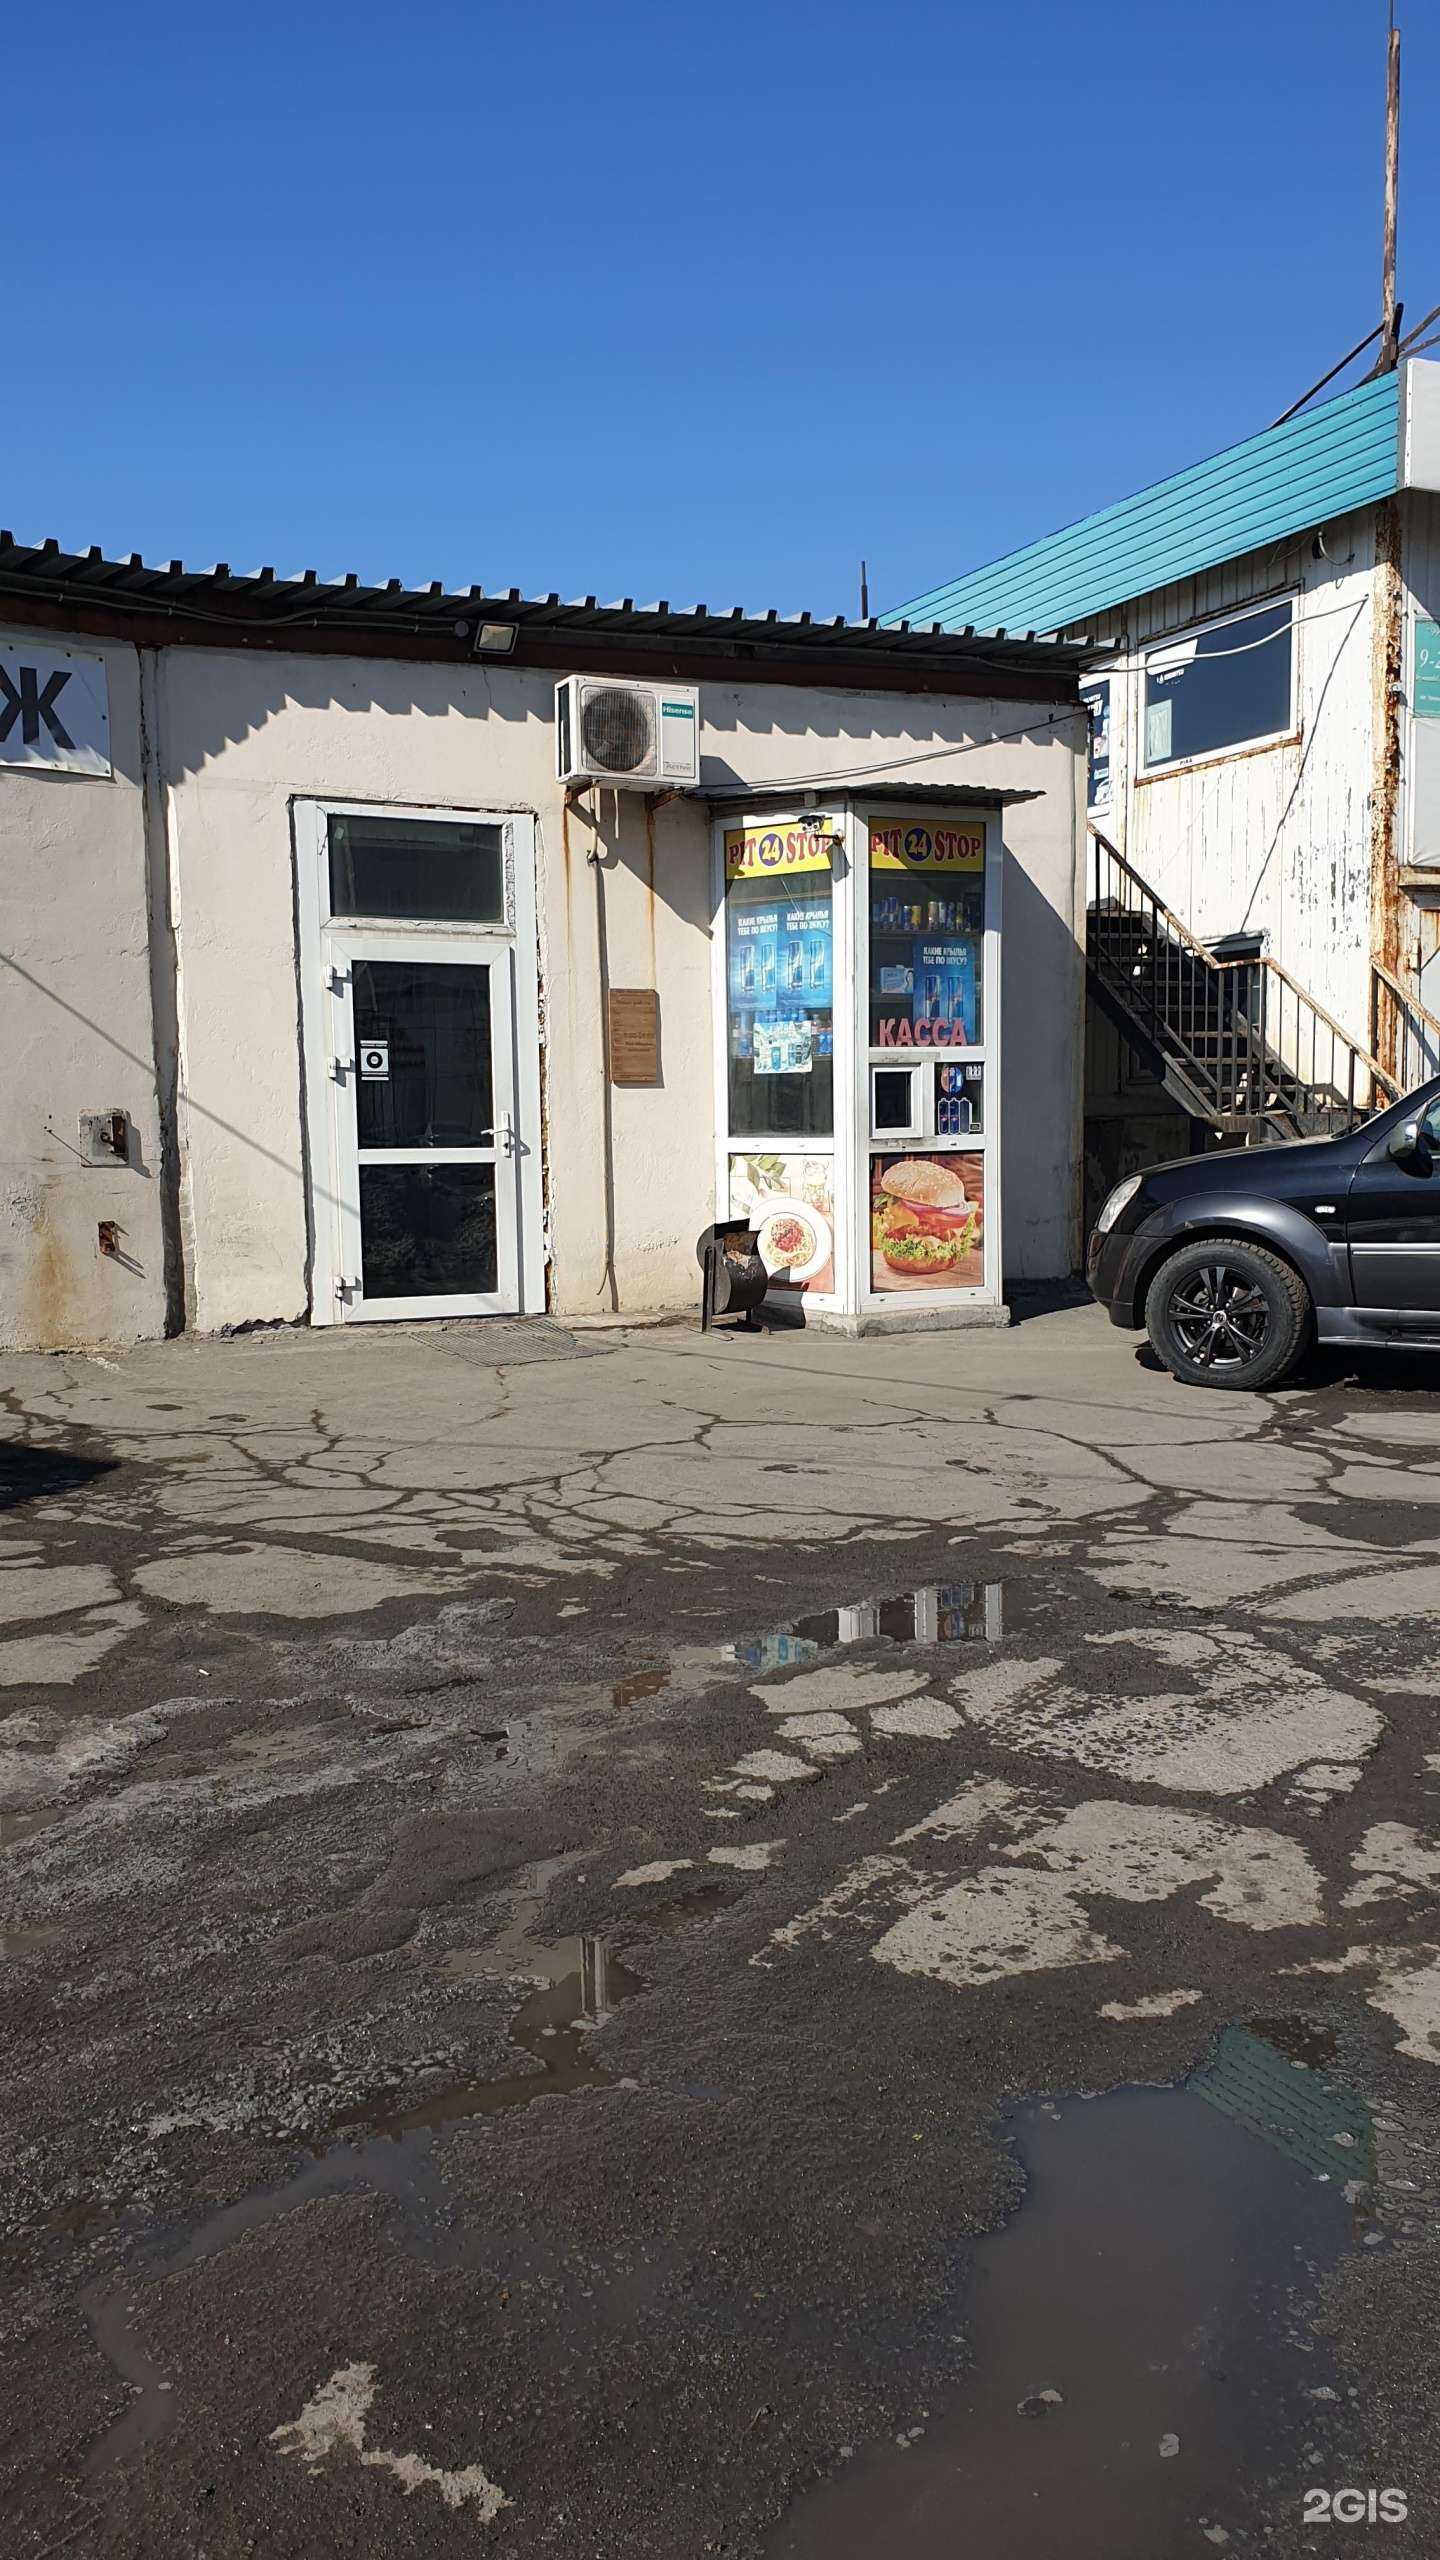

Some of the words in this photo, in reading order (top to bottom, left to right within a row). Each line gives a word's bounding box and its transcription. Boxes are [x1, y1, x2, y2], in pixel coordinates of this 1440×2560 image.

[663, 705, 693, 715] Hisense
[729, 837, 756, 867] PIT
[761, 837, 780, 862] 24
[786, 831, 832, 864] STOP
[870, 828, 901, 859] PIT
[909, 832, 928, 857] 24
[934, 830, 981, 862] STOP
[935, 956, 945, 965] ПО
[879, 1017, 967, 1047] КАССА
